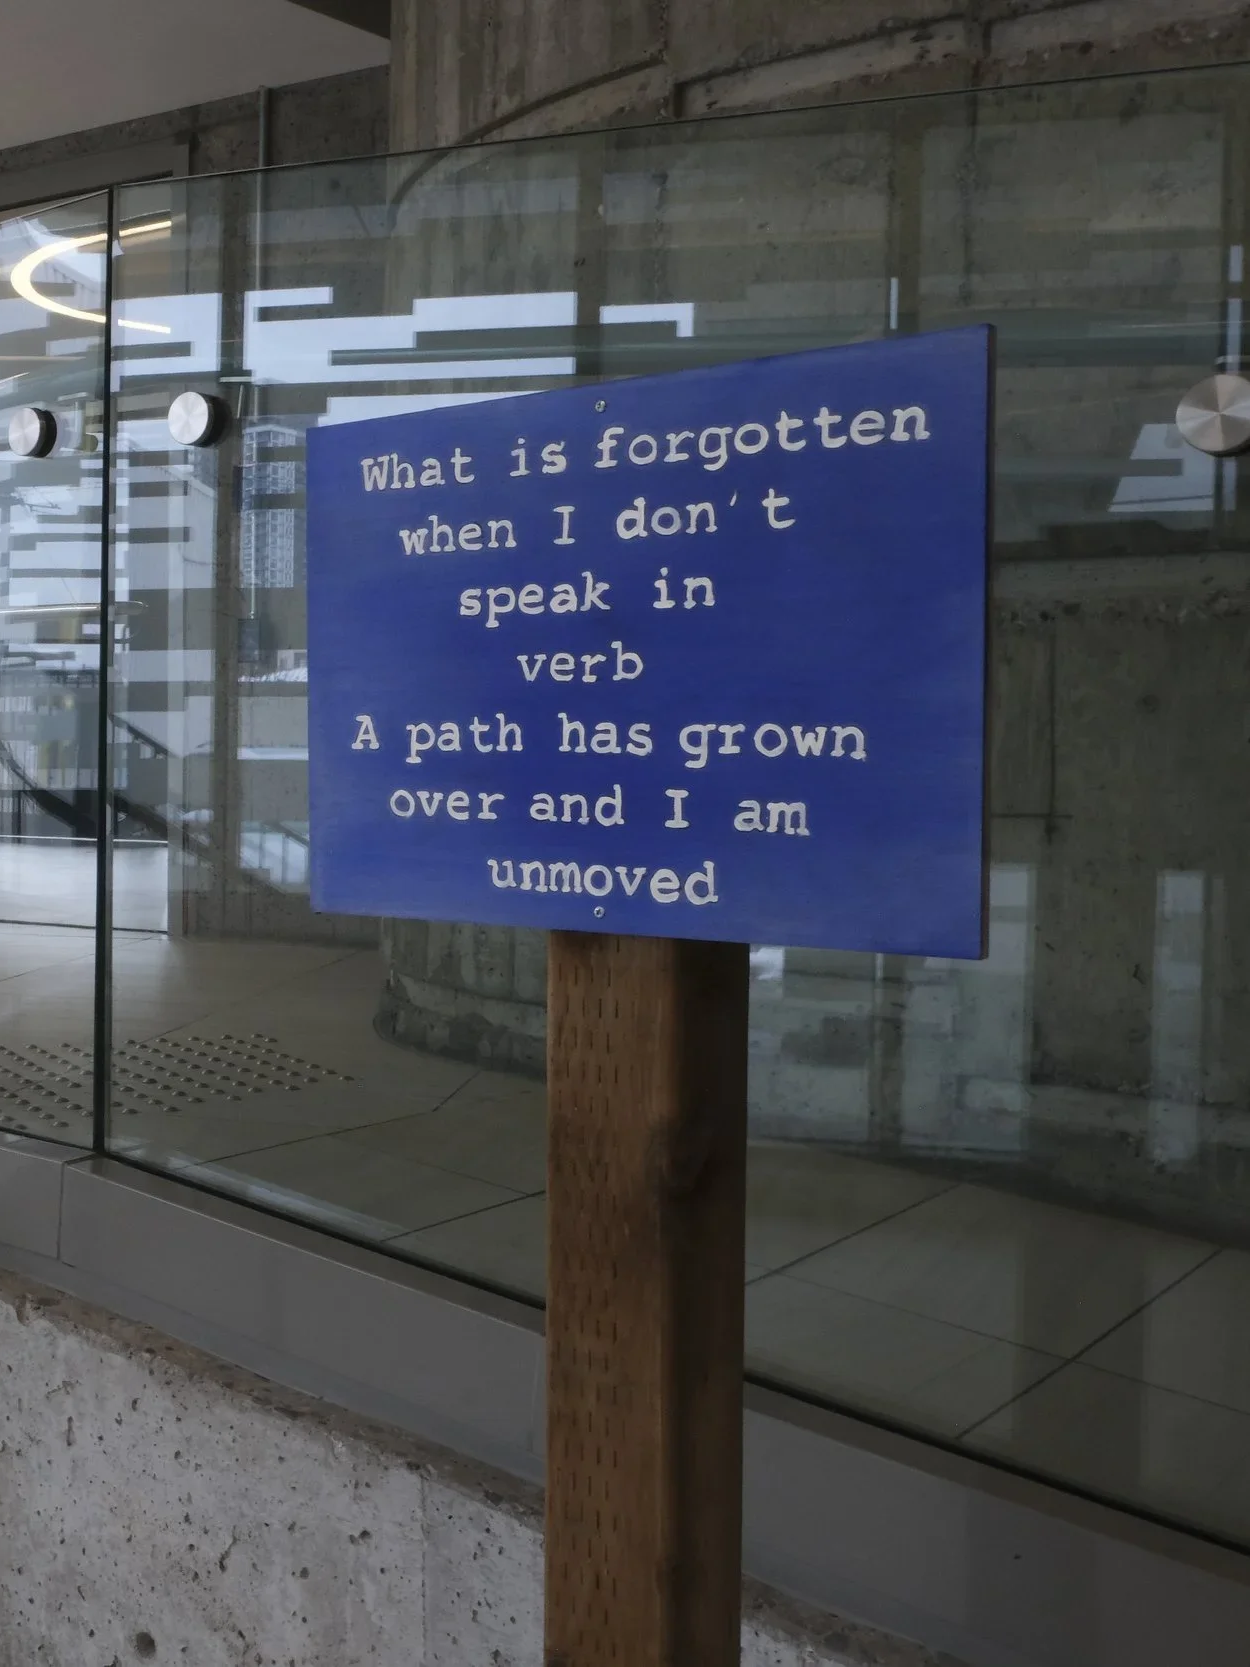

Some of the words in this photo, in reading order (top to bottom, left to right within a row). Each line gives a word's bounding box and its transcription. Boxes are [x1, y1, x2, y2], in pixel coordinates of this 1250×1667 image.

[361, 447, 475, 492] What
[510, 438, 566, 477] is
[595, 404, 930, 471] forgotten
[399, 515, 517, 556] when
[553, 505, 576, 545] I
[459, 572, 611, 628] speak
[652, 568, 716, 610] in
[516, 641, 644, 683] verb
[351, 714, 380, 750] A
[405, 712, 524, 764] path
[557, 712, 653, 757] has
[679, 723, 867, 769] grown
[389, 789, 505, 821] over
[529, 784, 625, 827] and
[664, 788, 689, 829] I
[733, 799, 810, 836] am
[487, 858, 719, 906] unmoved
